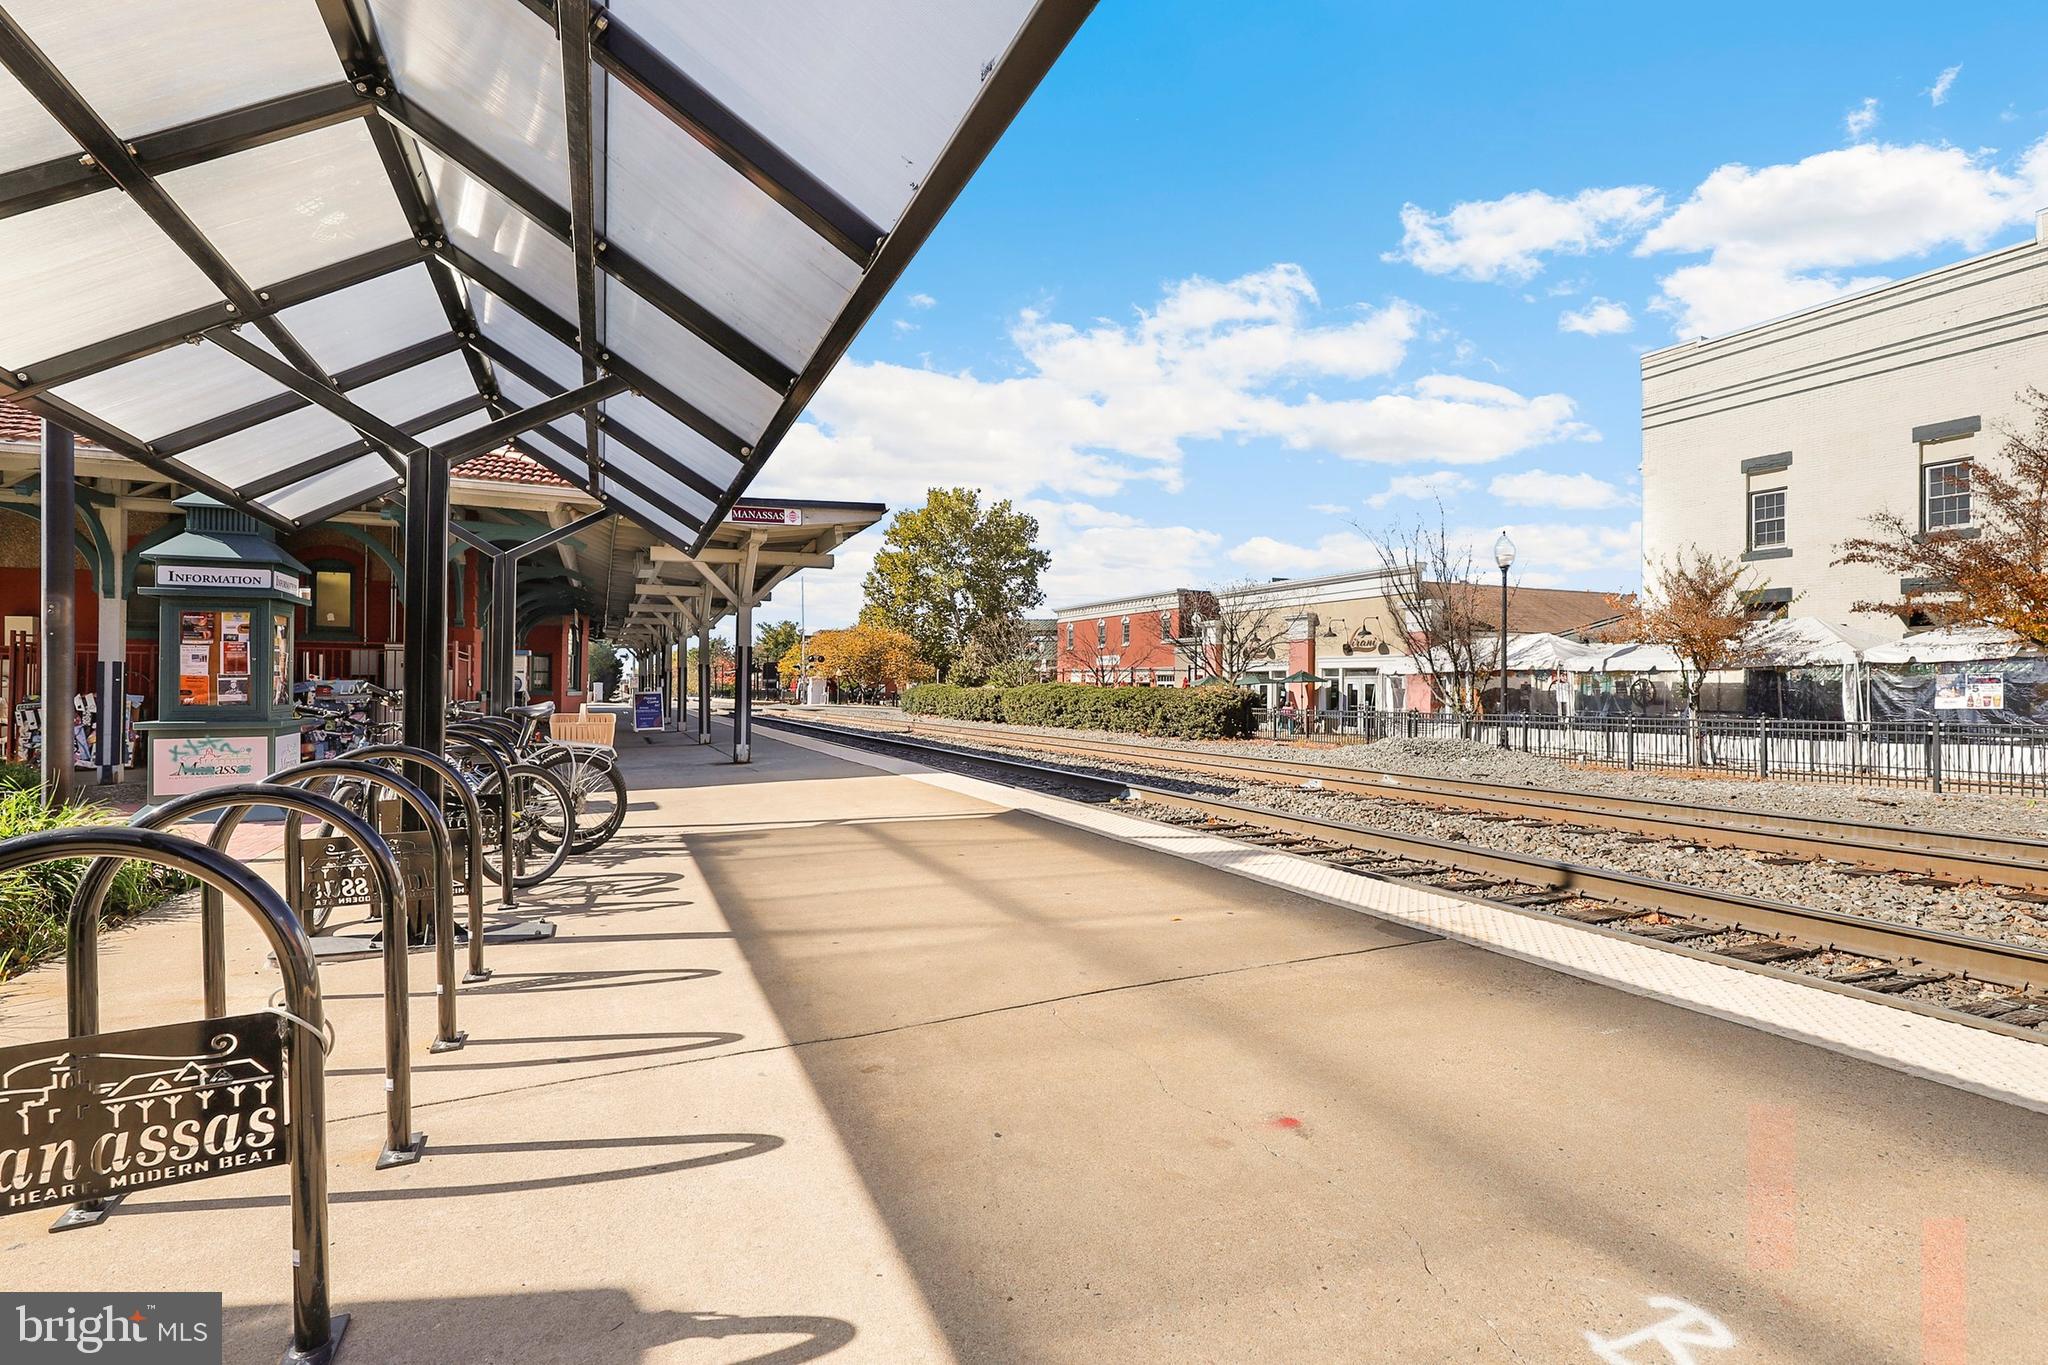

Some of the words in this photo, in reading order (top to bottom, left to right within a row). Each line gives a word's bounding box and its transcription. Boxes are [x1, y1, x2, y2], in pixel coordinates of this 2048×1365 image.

[732, 510, 785, 520] MANASSAS
[168, 570, 262, 585] INFORMATION
[110, 1161, 209, 1189] MODERN
[219, 1147, 276, 1169] BEAT
